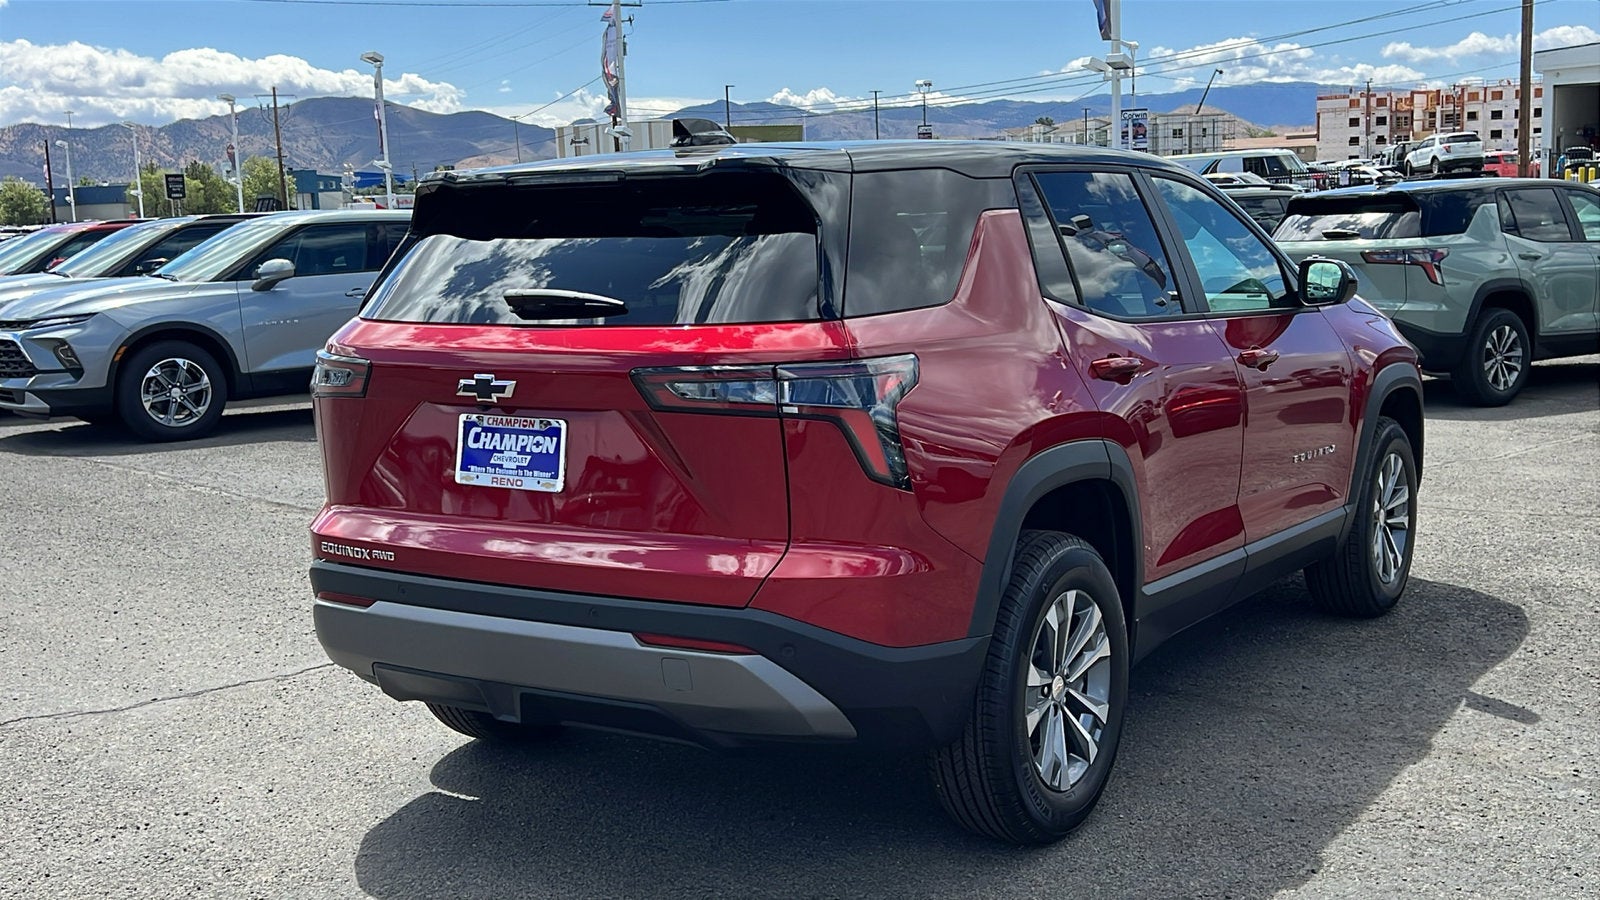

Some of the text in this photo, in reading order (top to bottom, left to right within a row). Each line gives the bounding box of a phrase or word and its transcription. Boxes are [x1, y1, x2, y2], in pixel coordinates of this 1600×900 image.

[487, 417, 536, 429] CHAMPION
[467, 427, 558, 454] CHAMPION
[493, 454, 528, 465] CHEVROLET
[491, 477, 524, 488] RENO
[321, 541, 395, 561] EQUINOX AWD
